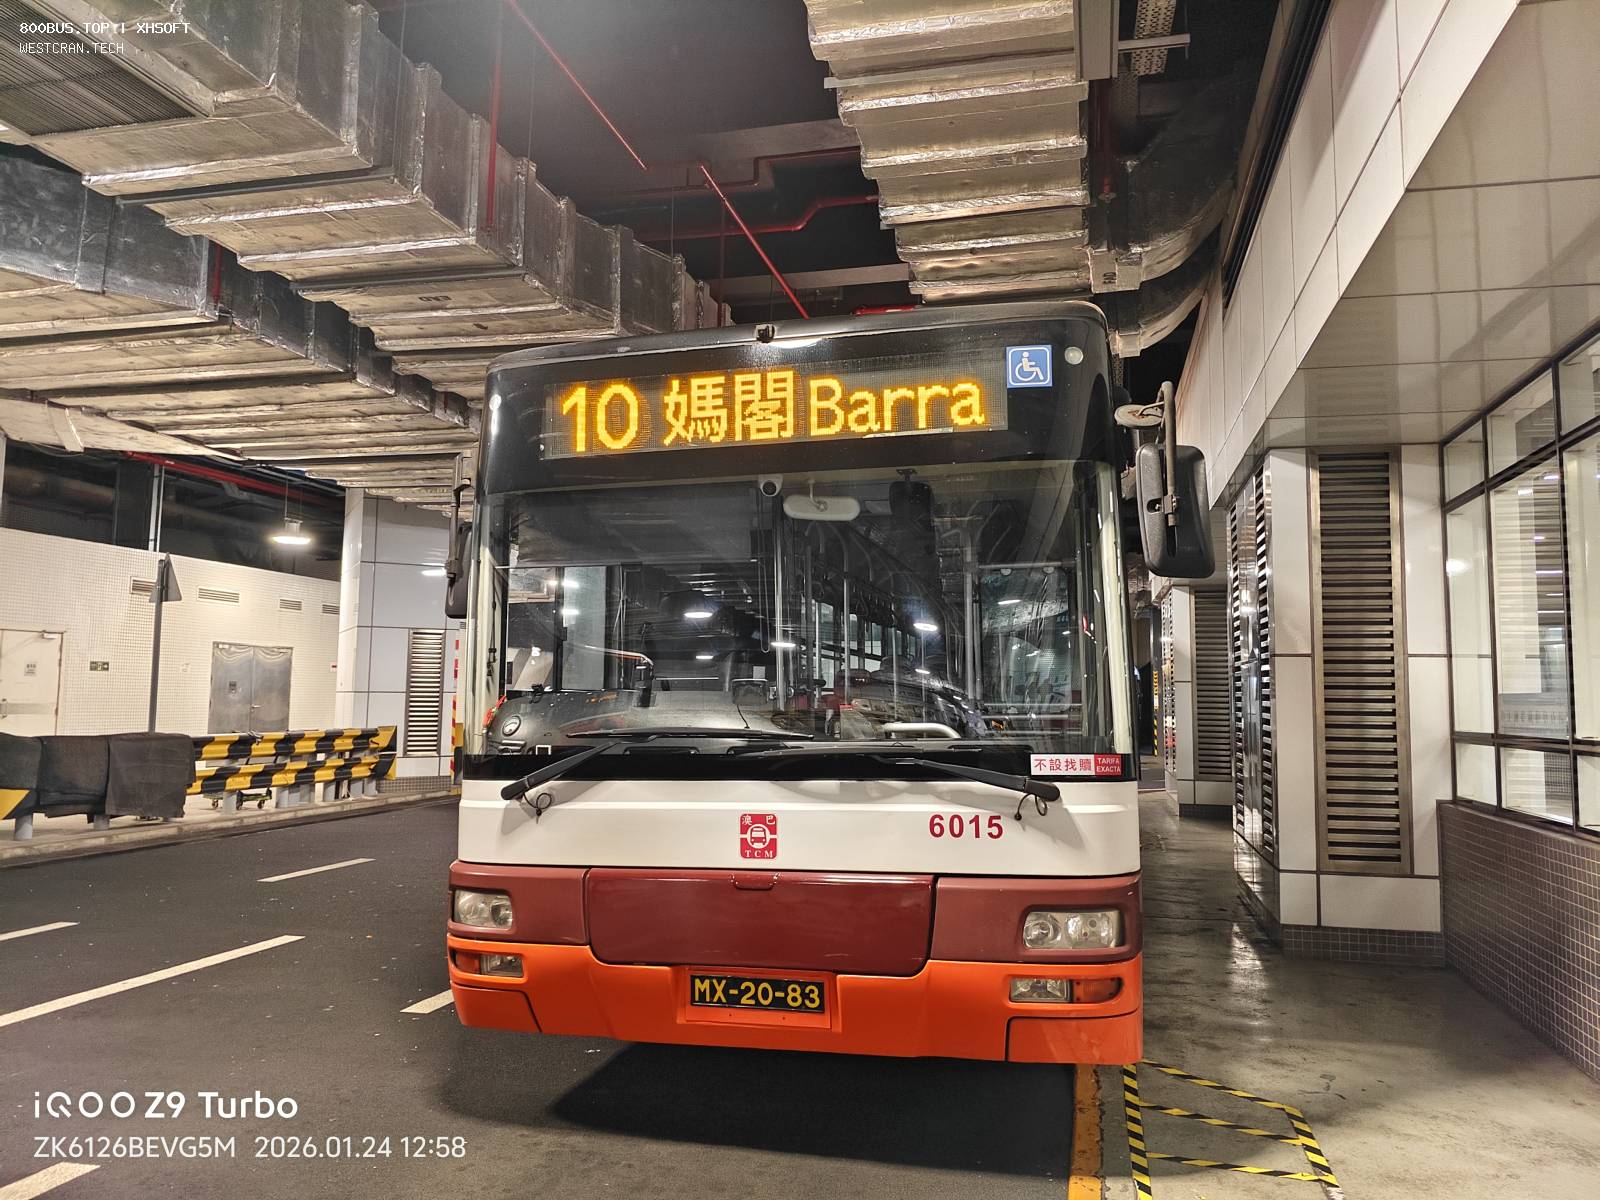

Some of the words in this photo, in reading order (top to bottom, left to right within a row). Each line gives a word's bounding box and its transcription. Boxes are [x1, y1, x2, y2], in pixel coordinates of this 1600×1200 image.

[562, 384, 639, 452] 10
[663, 370, 794, 446] 媽閣
[809, 376, 985, 436] Barra
[1096, 765, 1121, 773] EXACTA
[1097, 757, 1120, 765] TARIFA
[929, 814, 1003, 839] 6015
[694, 978, 820, 1009] MX-20-83
